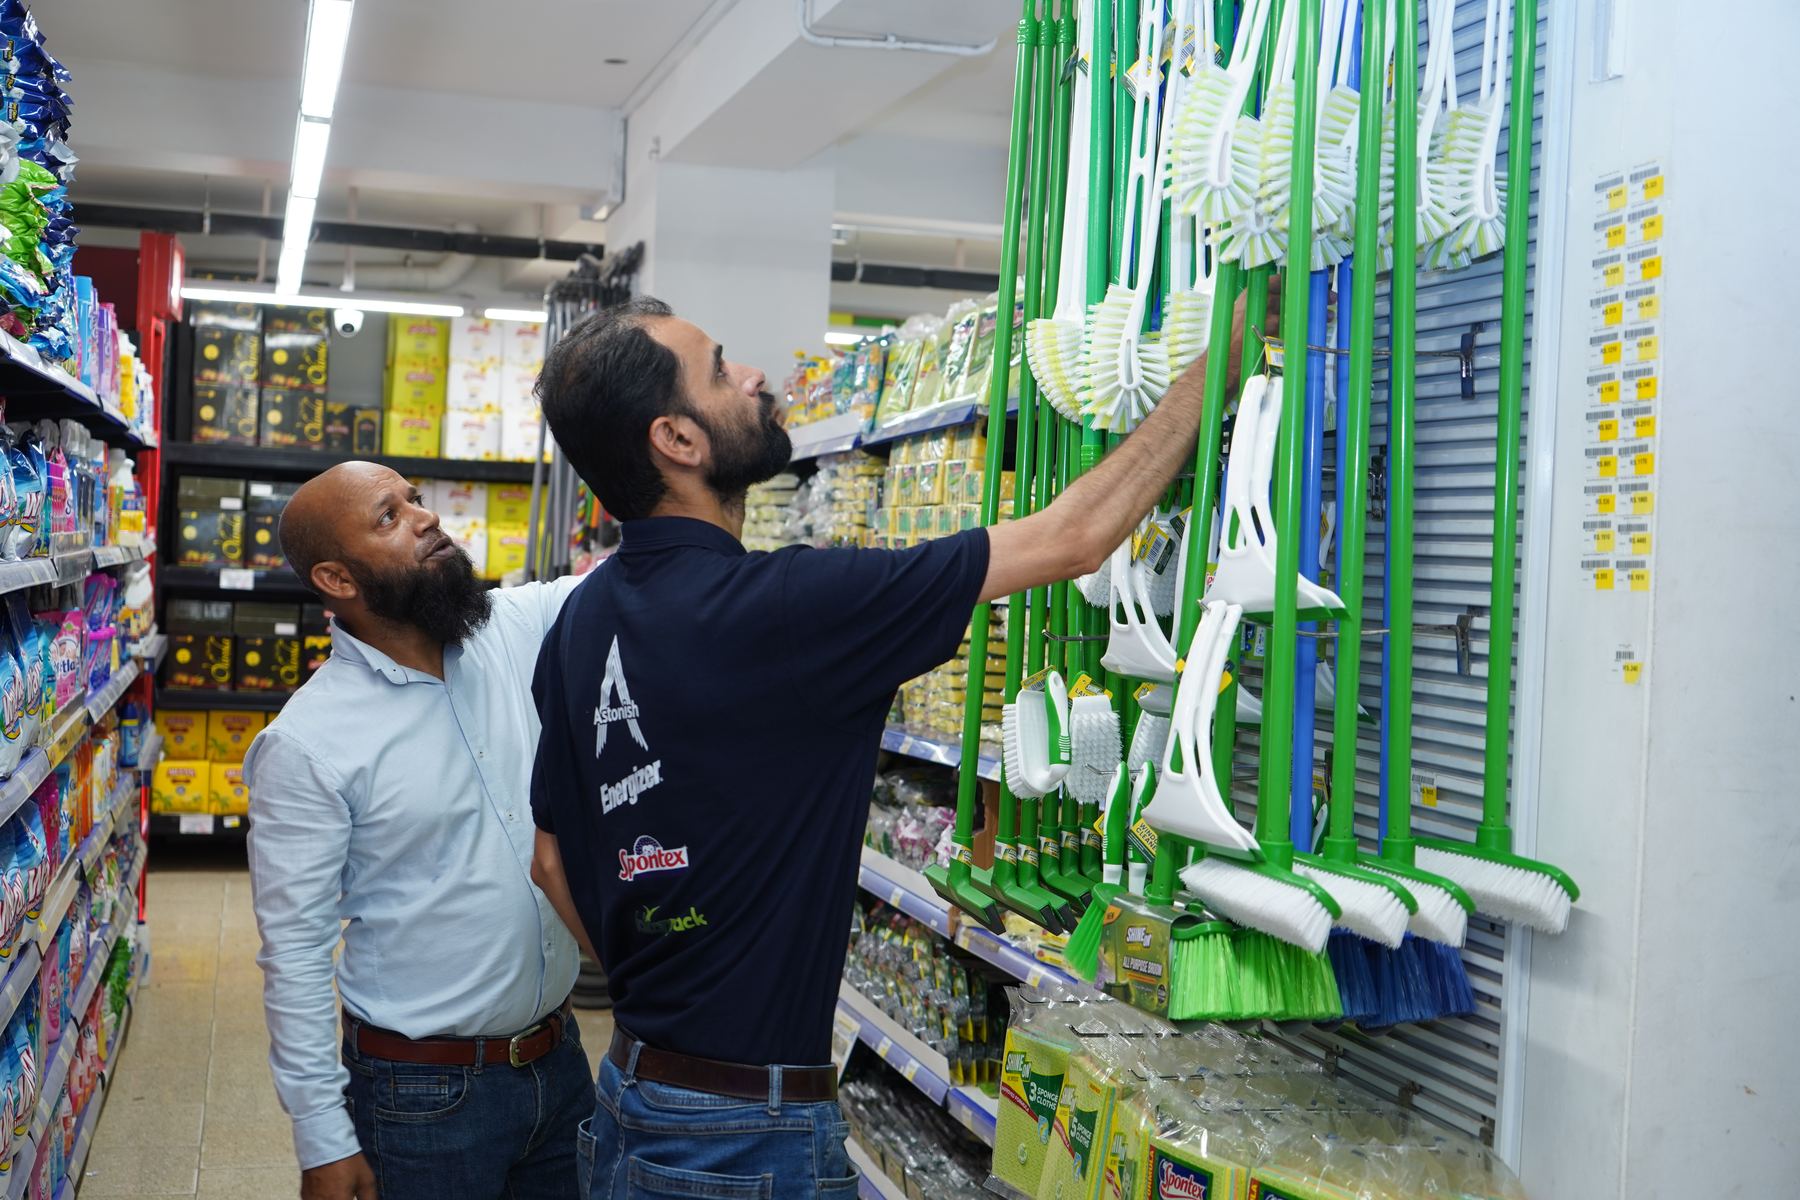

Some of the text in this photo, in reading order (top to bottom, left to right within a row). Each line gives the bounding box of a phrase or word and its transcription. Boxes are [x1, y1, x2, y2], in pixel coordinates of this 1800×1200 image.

[593, 699, 640, 726] Astonish
[619, 848, 687, 880] Spontex
[1029, 1081, 1038, 1102] 3
[1037, 1087, 1059, 1103] SPONGE
[1036, 1096, 1057, 1111] CLOTHS
[1070, 1116, 1078, 1138] 5
[1164, 1162, 1204, 1198] Spontex
